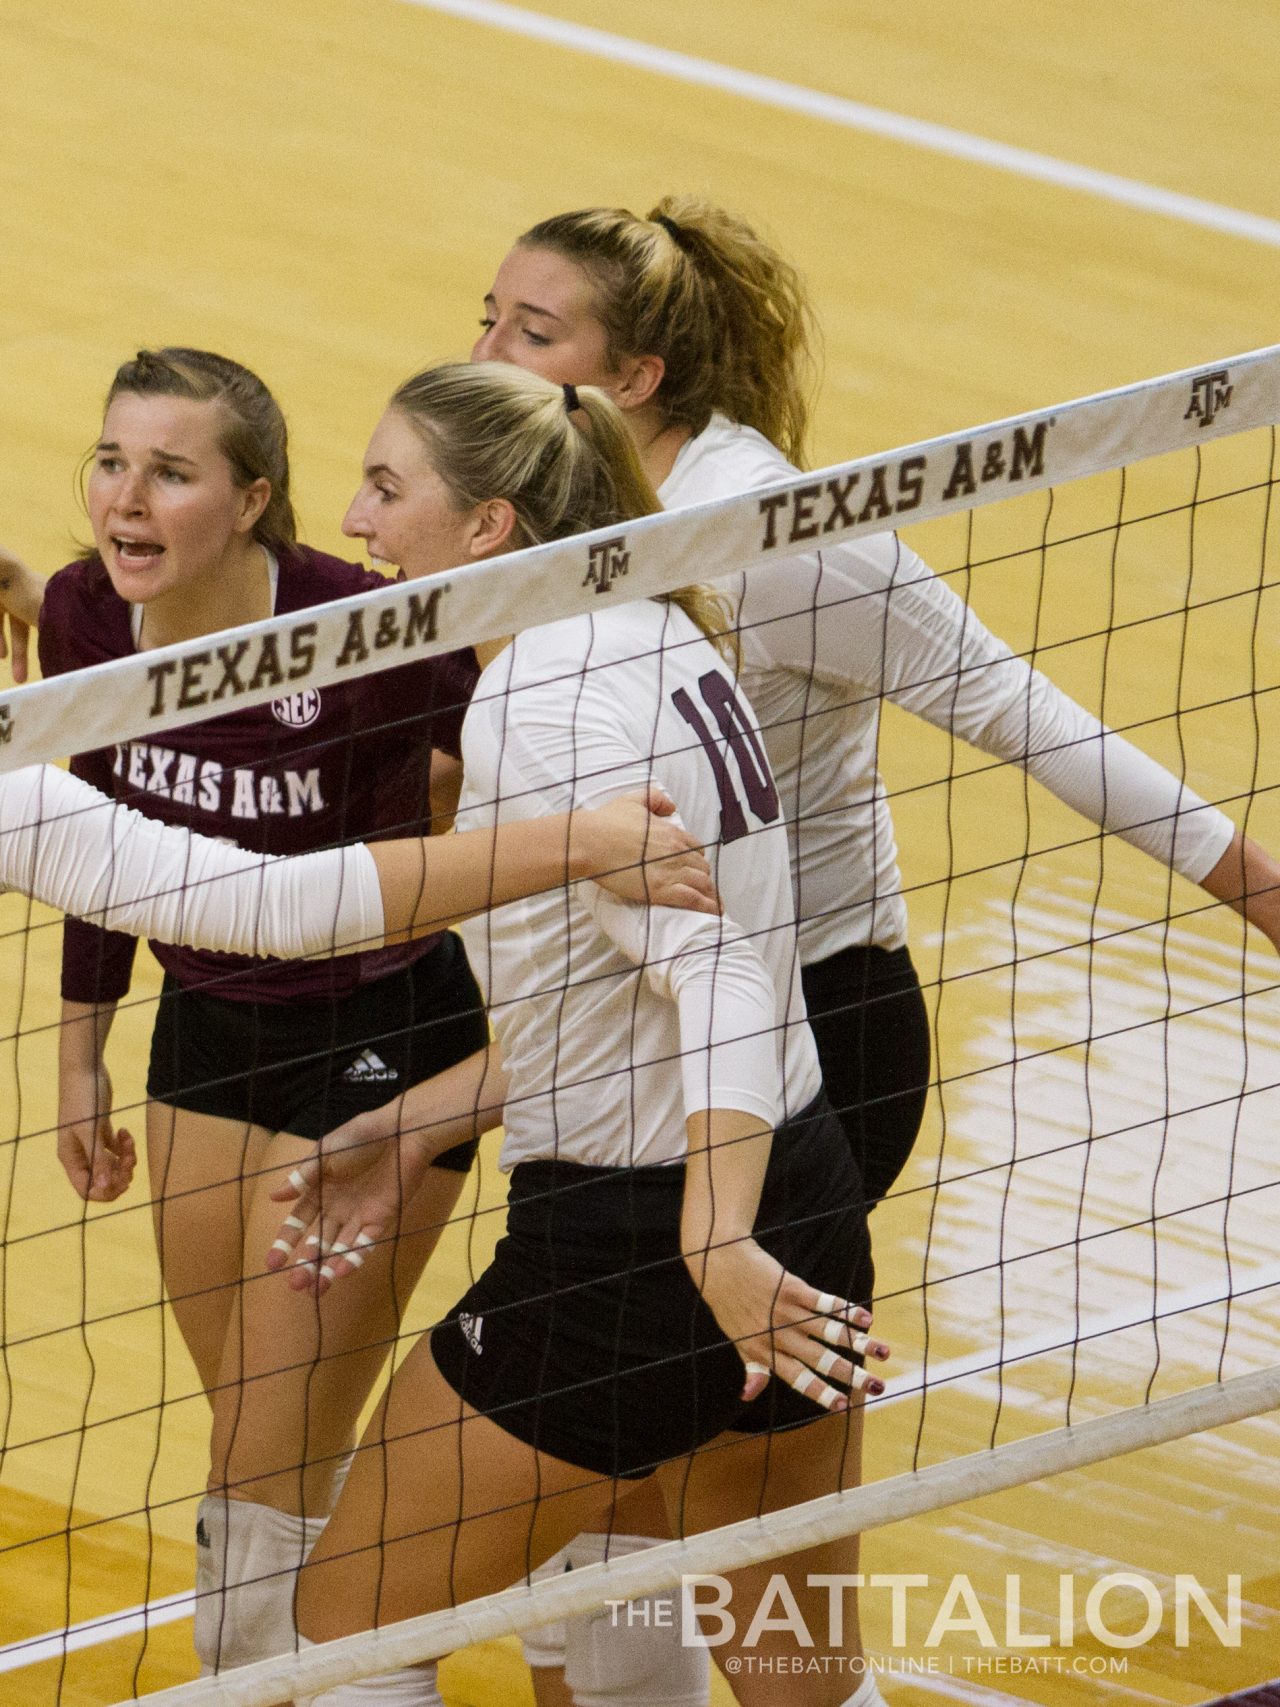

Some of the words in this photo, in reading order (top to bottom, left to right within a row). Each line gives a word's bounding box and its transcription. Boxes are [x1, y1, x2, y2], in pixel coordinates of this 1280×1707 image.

[759, 454, 928, 551] TEXAS
[942, 420, 1048, 501] A&M
[148, 622, 319, 719] TEXAS
[335, 587, 445, 669] A&M
[273, 689, 319, 726] SEC
[231, 767, 325, 820] A&M
[670, 668, 780, 846] 10
